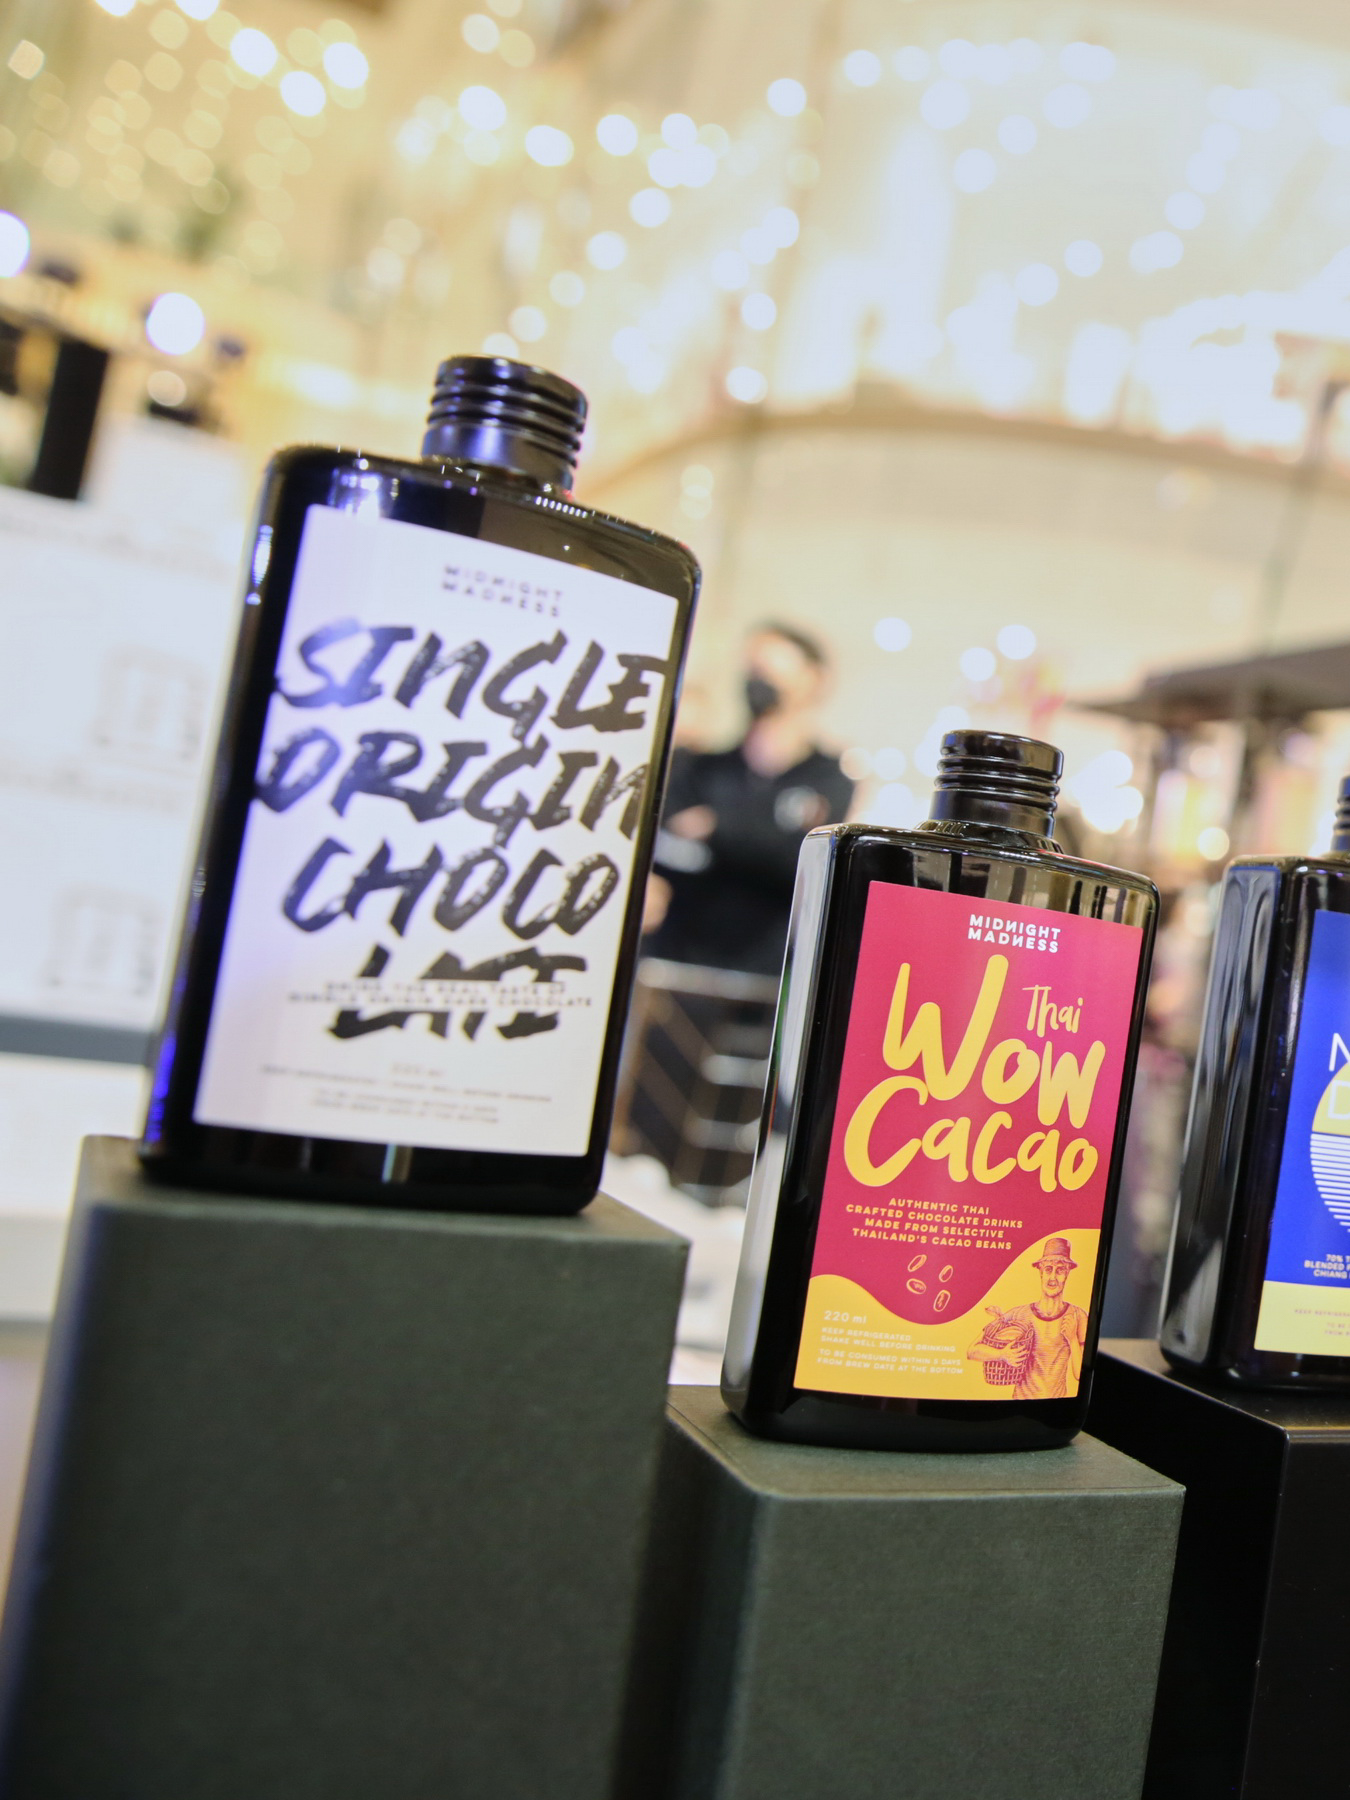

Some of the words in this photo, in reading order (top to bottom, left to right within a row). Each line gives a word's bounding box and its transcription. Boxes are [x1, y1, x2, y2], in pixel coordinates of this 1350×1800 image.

[444, 565, 562, 600] MIDNIGHT
[442, 582, 559, 617] MADNESS
[275, 618, 673, 743] SINGLE
[255, 726, 650, 848] ORIGIN
[281, 837, 620, 940] CHOCO
[968, 913, 1061, 942] MIDNIGHT
[967, 928, 1059, 954] MADNESS
[1022, 984, 1084, 1038] Thai
[843, 1075, 1099, 1193] Cacao
[846, 1204, 903, 1218] CRAFTED
[908, 1211, 979, 1226] CHOCOLATE
[983, 1218, 1023, 1229] DRINKS
[889, 1198, 958, 1212] AUTHENTIC
[963, 1205, 990, 1215] THAI
[852, 1228, 928, 1244] THAILAND'S
[932, 1236, 972, 1248] CACAO
[975, 1240, 1012, 1250] BEANS
[864, 1218, 900, 1230] MADE
[904, 1222, 938, 1233] FROM
[942, 1226, 1004, 1239] SELECTIVE
[1304, 1259, 1345, 1271] BLENDED
[1313, 1269, 1348, 1280] CHIANG
[823, 1310, 849, 1322] 220
[821, 1335, 850, 1345] SHAKE
[853, 1339, 876, 1348] WELL
[879, 1341, 912, 1350] BEFORE
[915, 1344, 956, 1352] DRINKING
[847, 1329, 912, 1341] REFRIGERATED
[817, 1357, 843, 1366] FROM
[846, 1360, 871, 1368] BREW
[874, 1363, 895, 1371] DATE
[820, 1348, 831, 1356] TO
[833, 1350, 845, 1358] BE
[848, 1351, 898, 1362] CONSUMED
[901, 1356, 931, 1364] WITHIN
